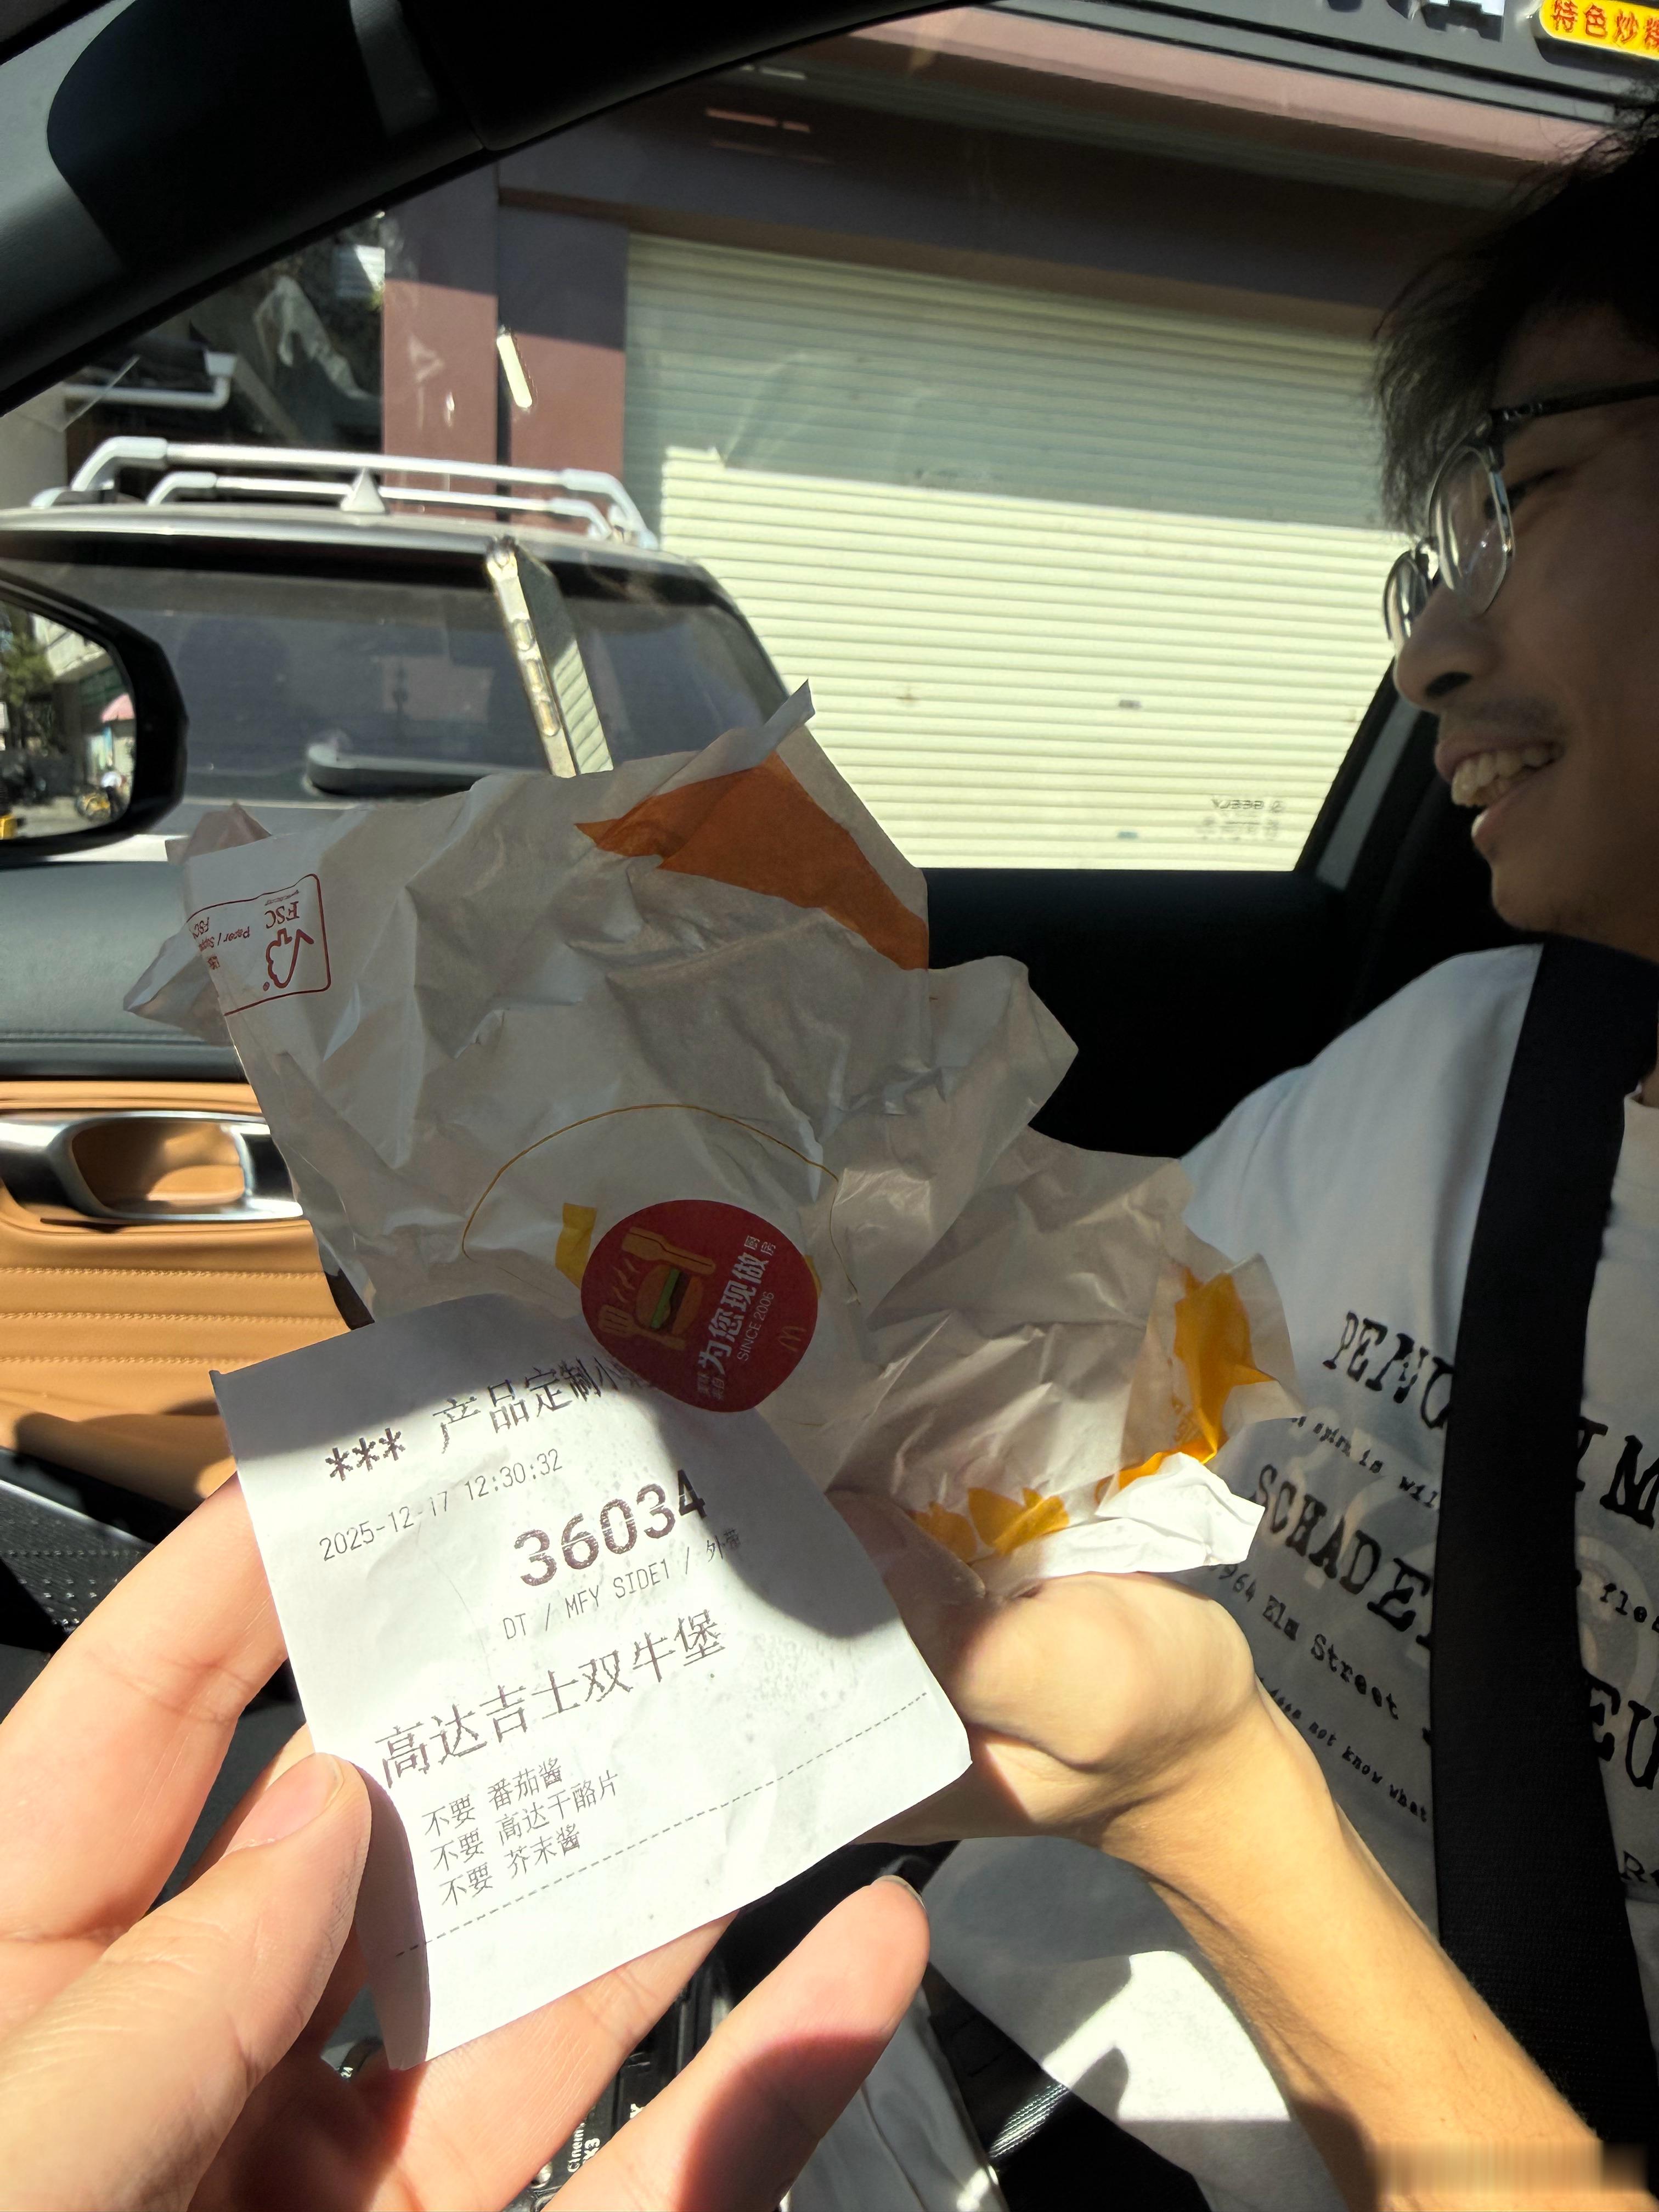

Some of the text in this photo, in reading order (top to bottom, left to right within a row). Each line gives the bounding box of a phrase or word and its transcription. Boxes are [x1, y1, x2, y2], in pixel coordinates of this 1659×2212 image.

[264, 901, 300, 929] FSC
[698, 1252, 769, 1376] 为您现做
[737, 1291, 775, 1362] SINCE 2006
[319, 1449, 563, 1562] 2025-12-17 12:30:32
[514, 1469, 707, 1586] 36034
[503, 1612, 526, 1639] DT
[545, 1602, 551, 1632] /
[565, 1585, 599, 1618] MFY
[613, 1558, 669, 1599] SIDE1
[685, 1547, 690, 1575] /
[375, 1609, 726, 1789] 高达吉士双牛堡
[1311, 1633, 1399, 1720] Street
[421, 1757, 562, 1837] 不要 番茄酱
[430, 1769, 618, 1871] 不要 高达干酪片
[1308, 1722, 1337, 1746] not
[1342, 1746, 1383, 1784] know
[1389, 1784, 1427, 1822] what
[439, 1823, 580, 1906] 不要 芥末酱
